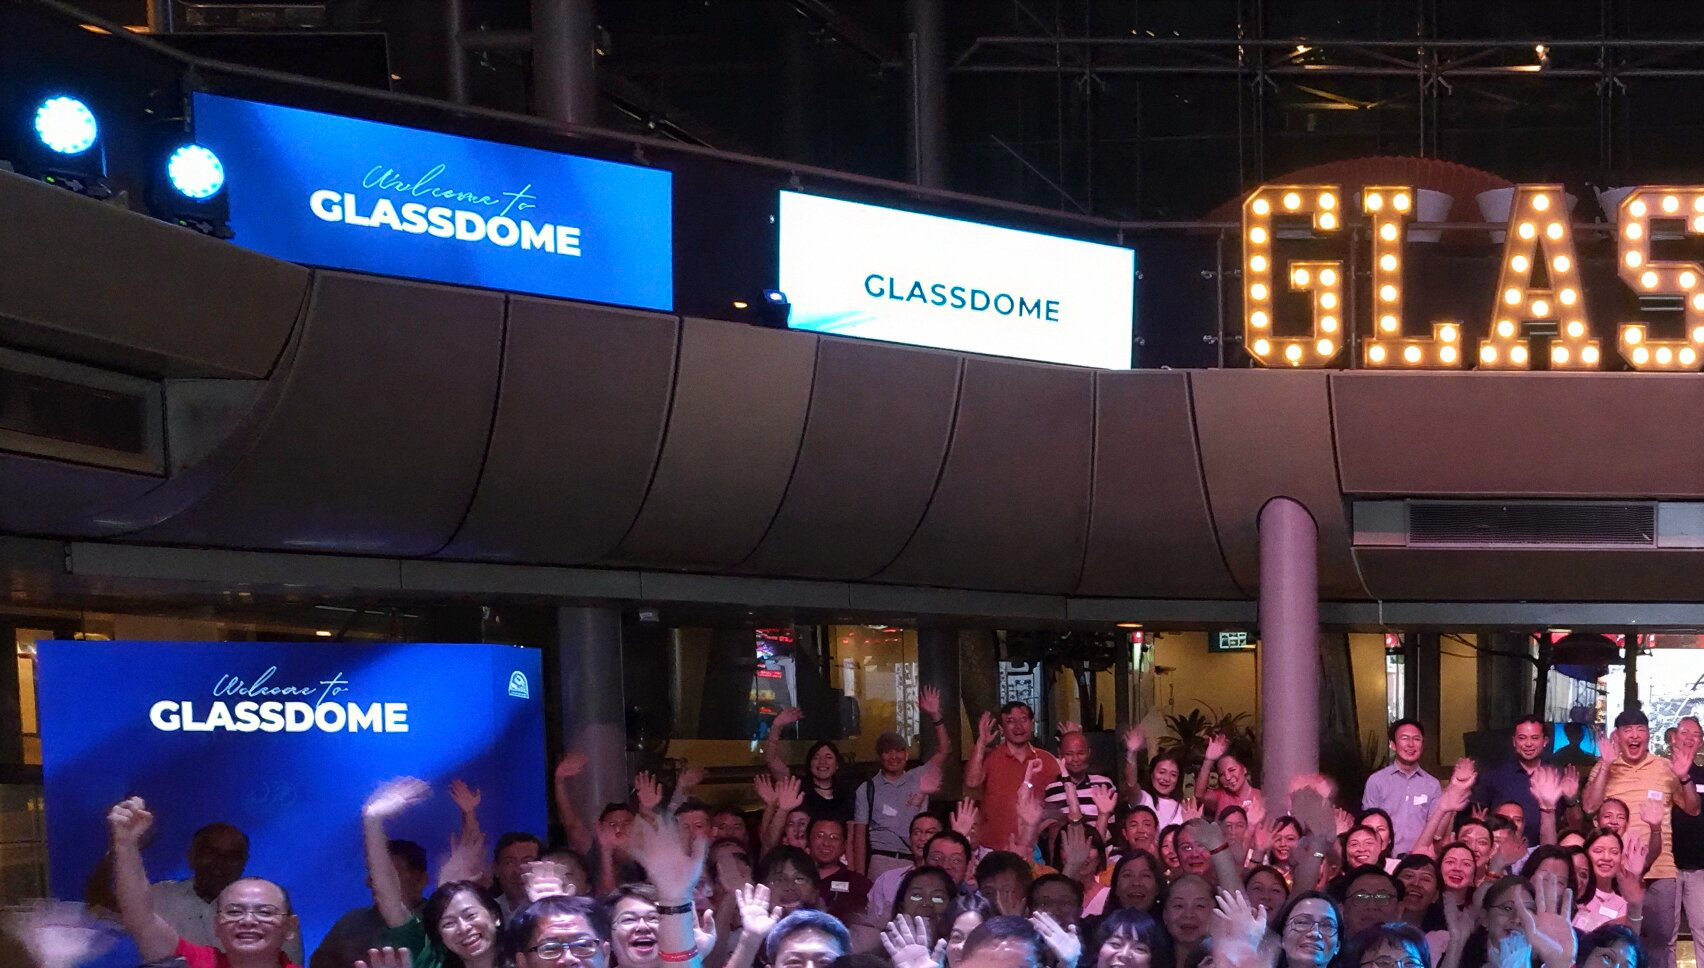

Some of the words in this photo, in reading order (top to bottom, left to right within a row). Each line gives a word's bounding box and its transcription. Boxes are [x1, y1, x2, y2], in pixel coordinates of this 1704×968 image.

[362, 164, 499, 206] Welcome
[499, 184, 537, 216] to
[309, 189, 581, 256] GLASSDOME
[864, 274, 1060, 322] GLASSDOME
[213, 666, 316, 697] Welcome
[316, 672, 349, 707] to
[149, 700, 409, 733] GLASSDOME
